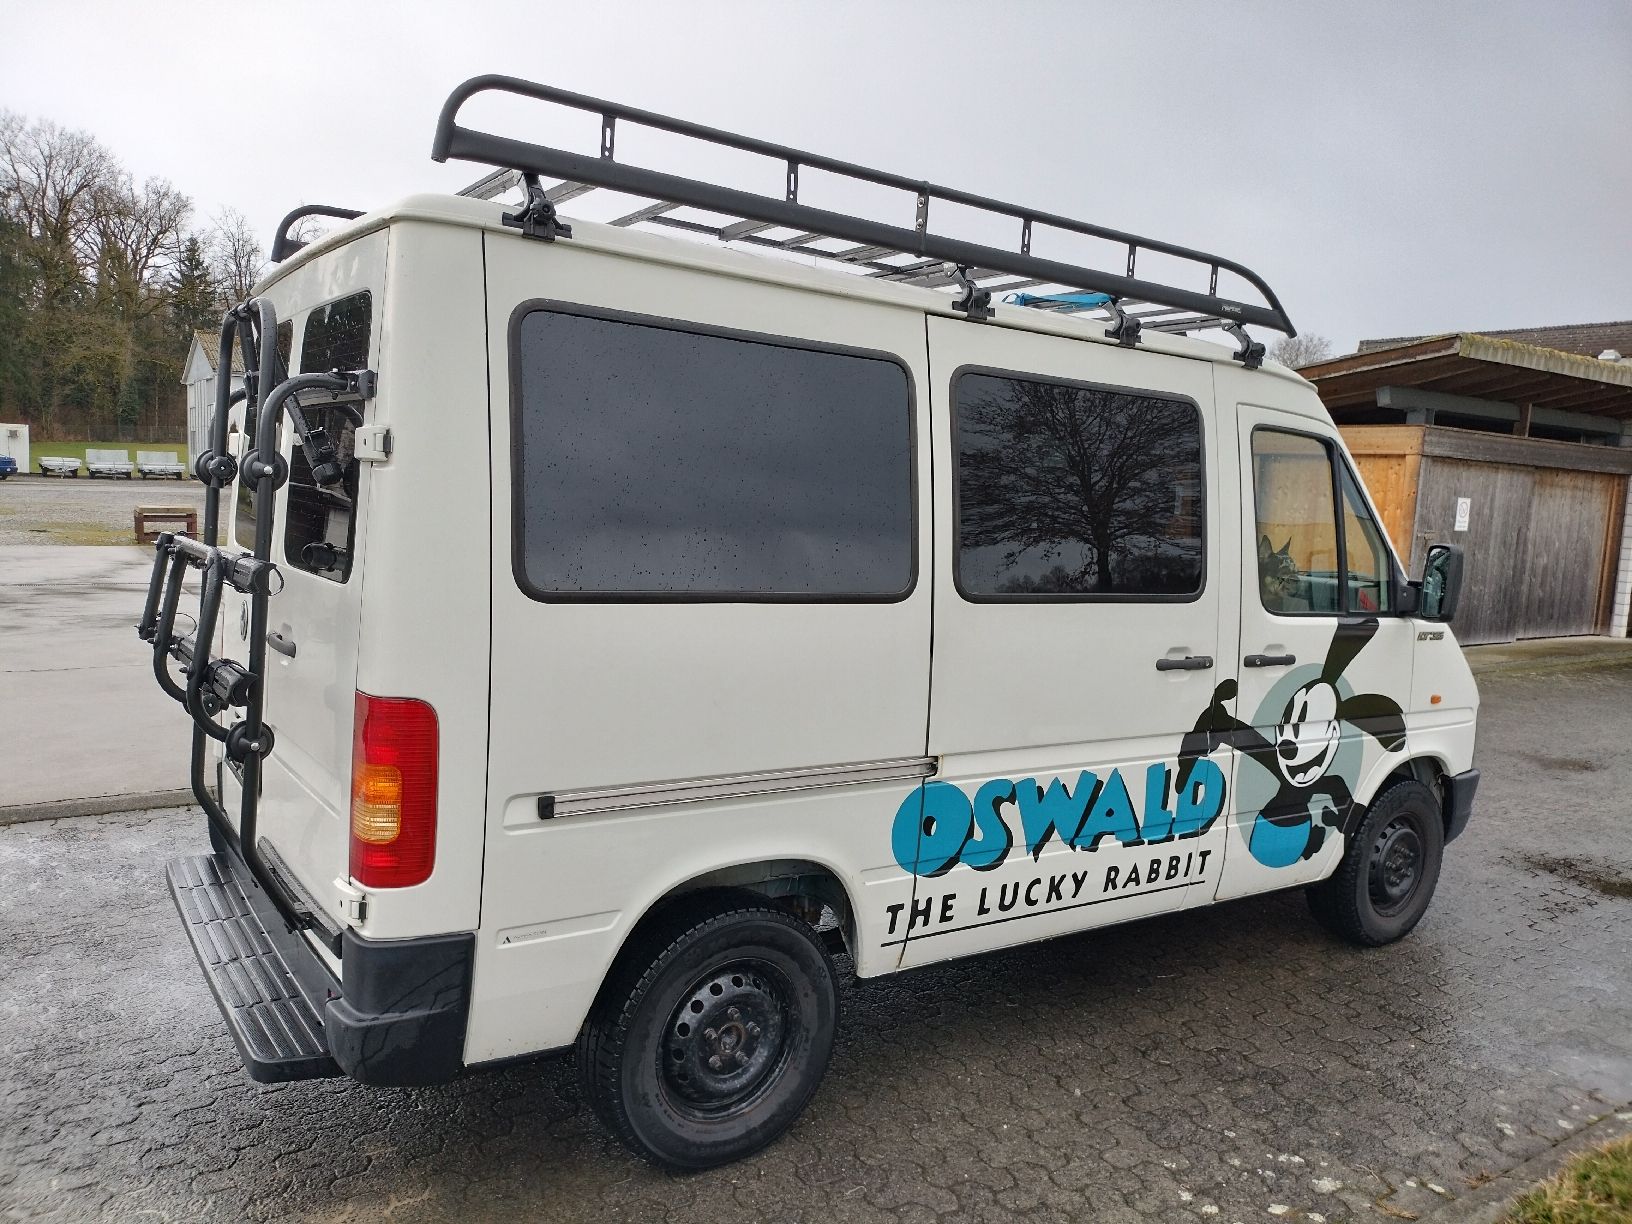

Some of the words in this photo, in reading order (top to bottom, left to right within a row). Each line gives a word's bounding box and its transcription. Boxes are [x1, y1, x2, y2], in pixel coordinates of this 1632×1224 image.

[891, 758, 1226, 878] OSWALD
[886, 893, 957, 934] THE
[977, 871, 1088, 916] LUCKY
[1103, 850, 1212, 893] RABBIT
